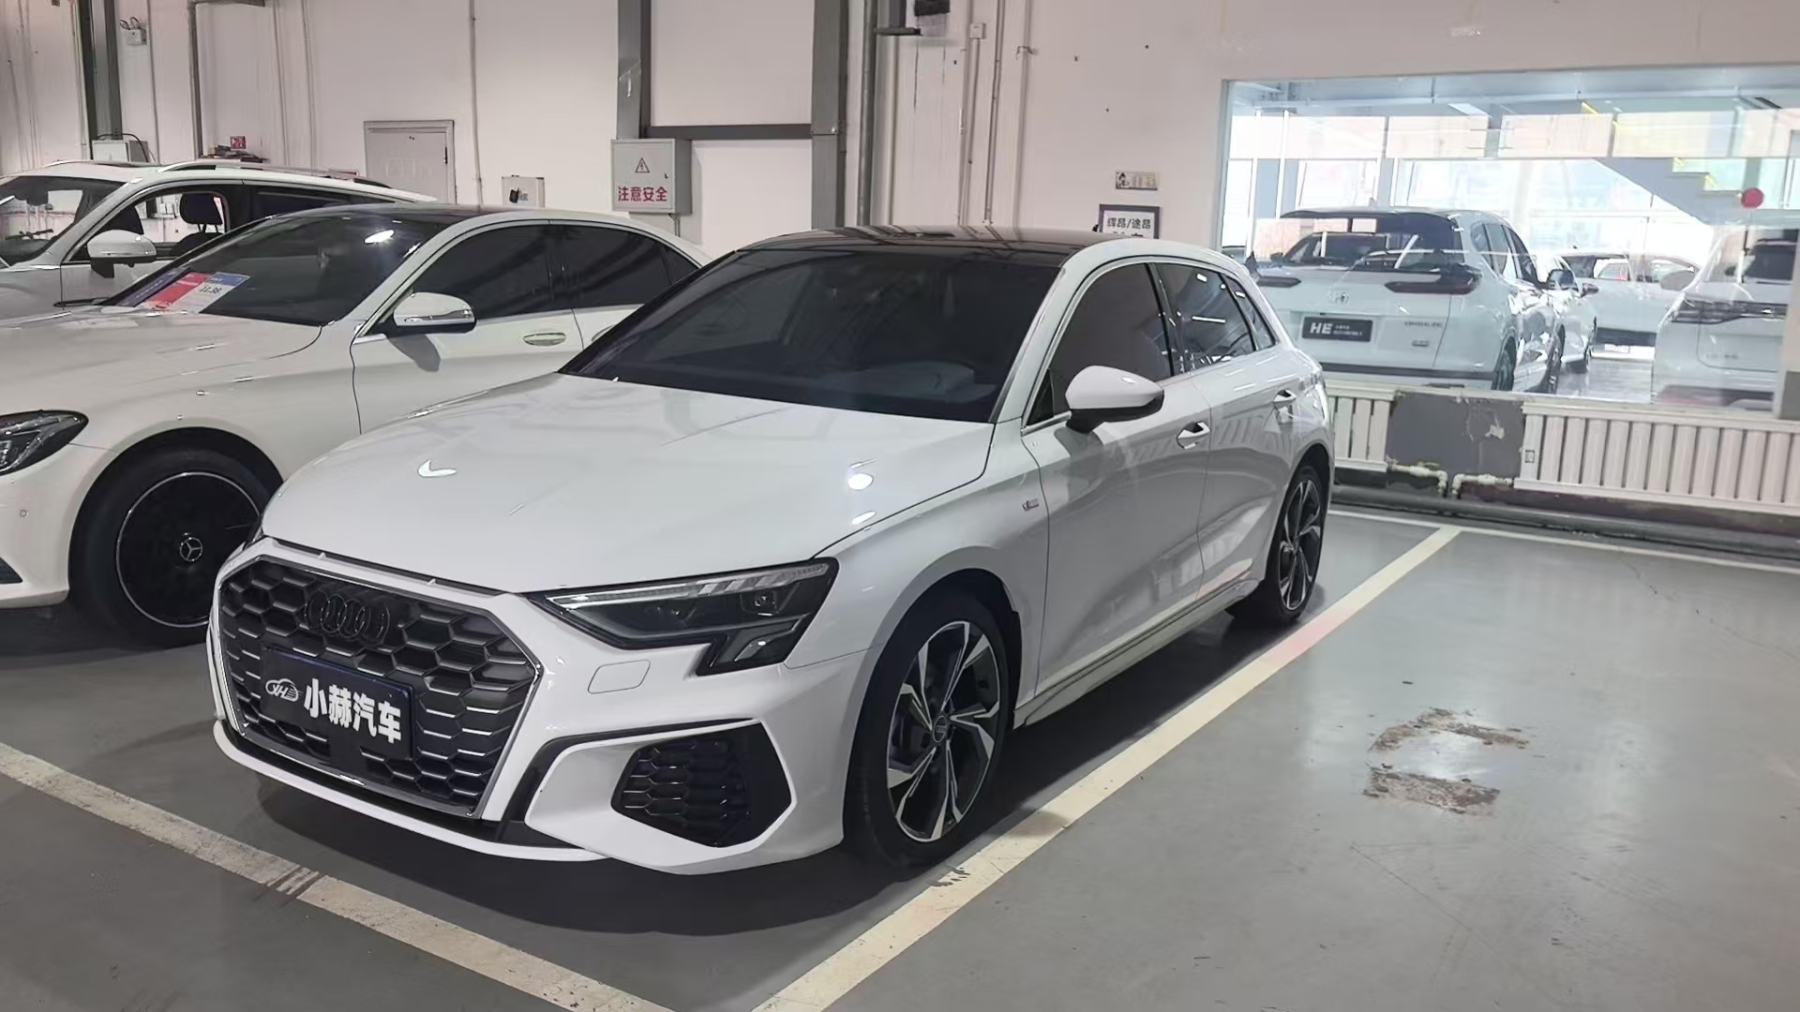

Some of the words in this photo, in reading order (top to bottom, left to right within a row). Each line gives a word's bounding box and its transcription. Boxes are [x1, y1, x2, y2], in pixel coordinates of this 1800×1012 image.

[618, 186, 667, 202] 注意安全
[1107, 217, 1151, 229] 辉昂/途昂
[1309, 322, 1333, 335] HE
[304, 678, 401, 744] 小赫汽车
